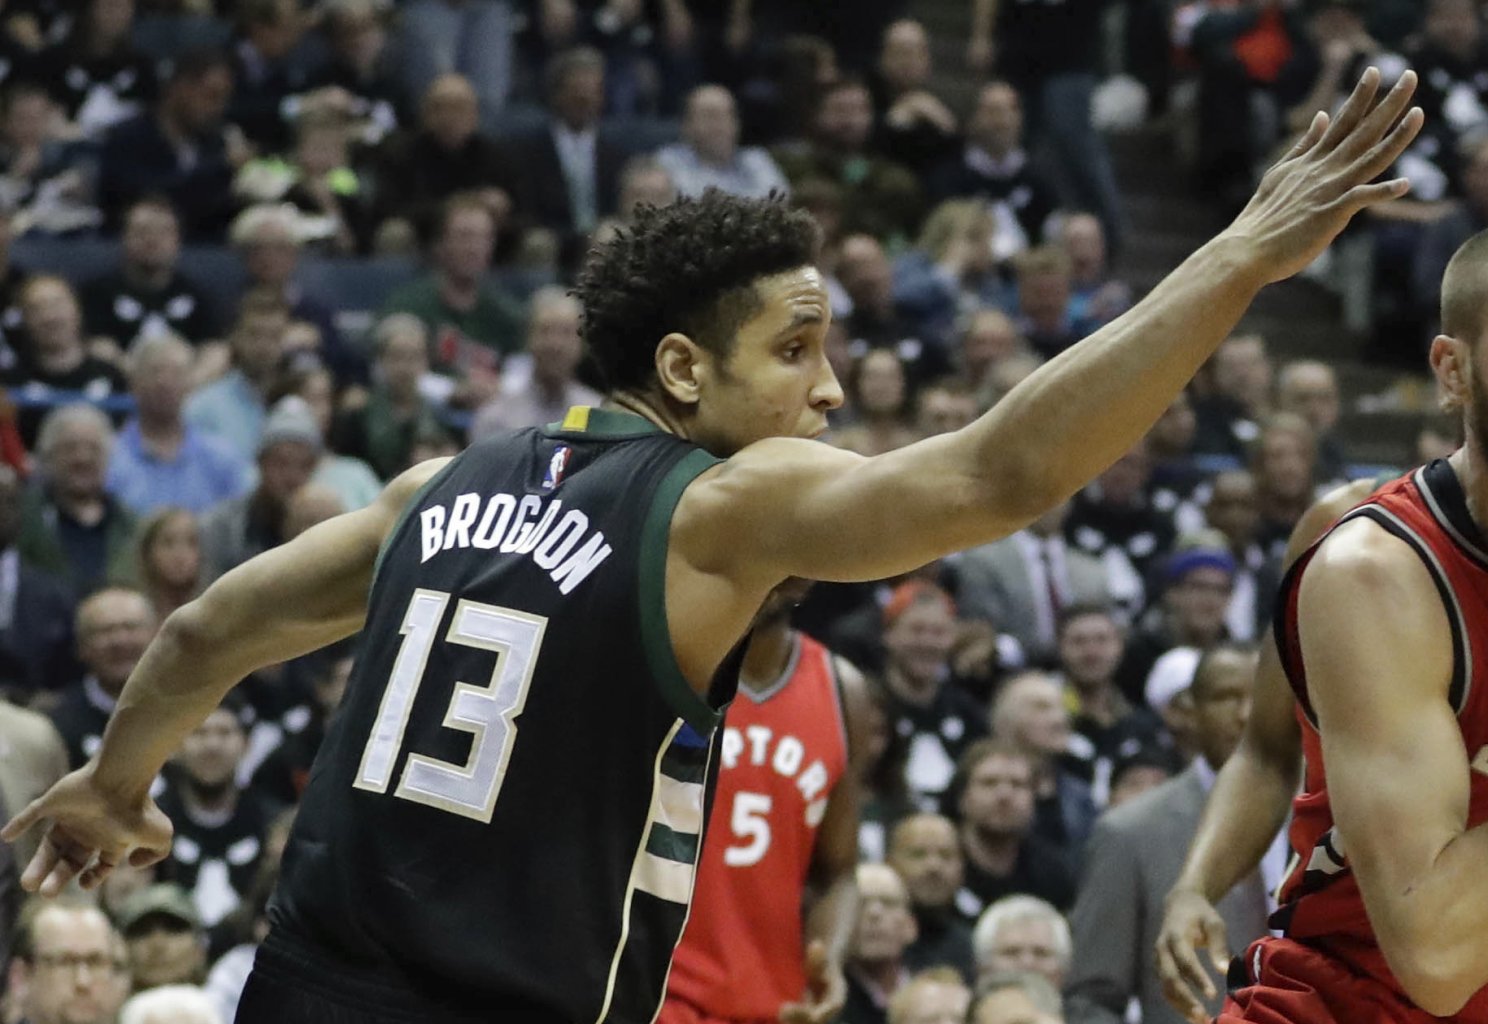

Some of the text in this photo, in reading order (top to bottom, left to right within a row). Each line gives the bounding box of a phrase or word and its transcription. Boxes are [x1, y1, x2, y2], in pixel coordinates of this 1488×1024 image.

[352, 587, 549, 823] 13
[722, 725, 828, 828] PTOR
[724, 791, 773, 867] 5
